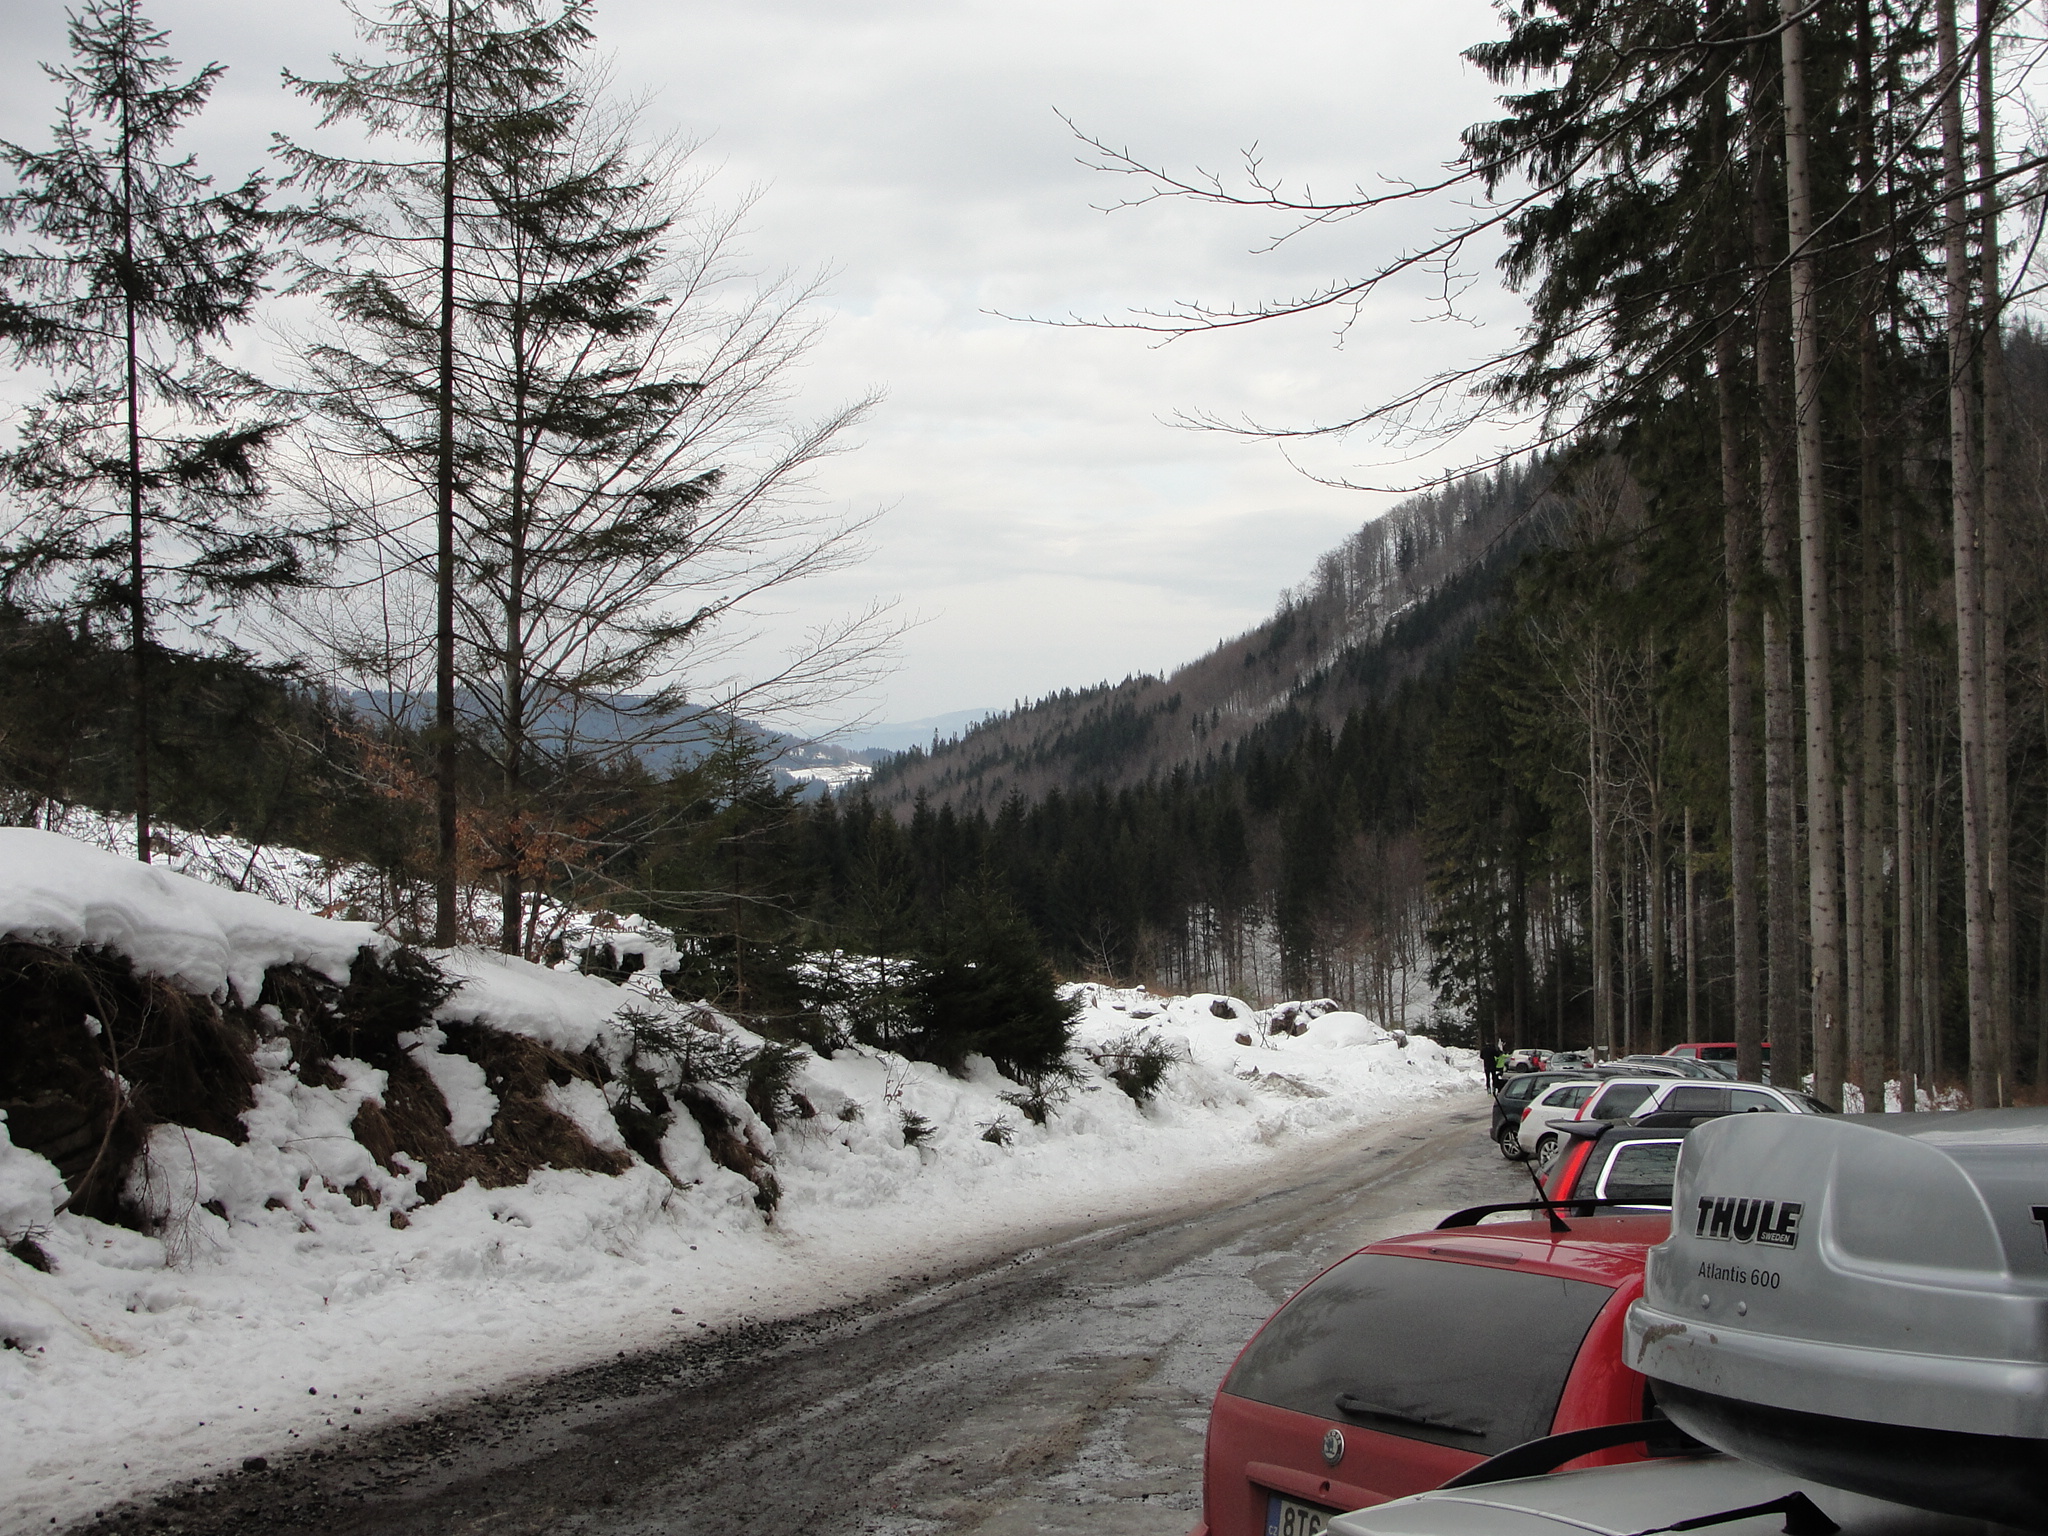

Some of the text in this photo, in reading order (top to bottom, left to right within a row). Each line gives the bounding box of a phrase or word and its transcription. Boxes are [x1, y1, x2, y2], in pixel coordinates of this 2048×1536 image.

[1696, 1196, 1803, 1246] THULE
[1760, 1232, 1791, 1243] SWEDEN
[1698, 1261, 1780, 1289] Atlantis 600
